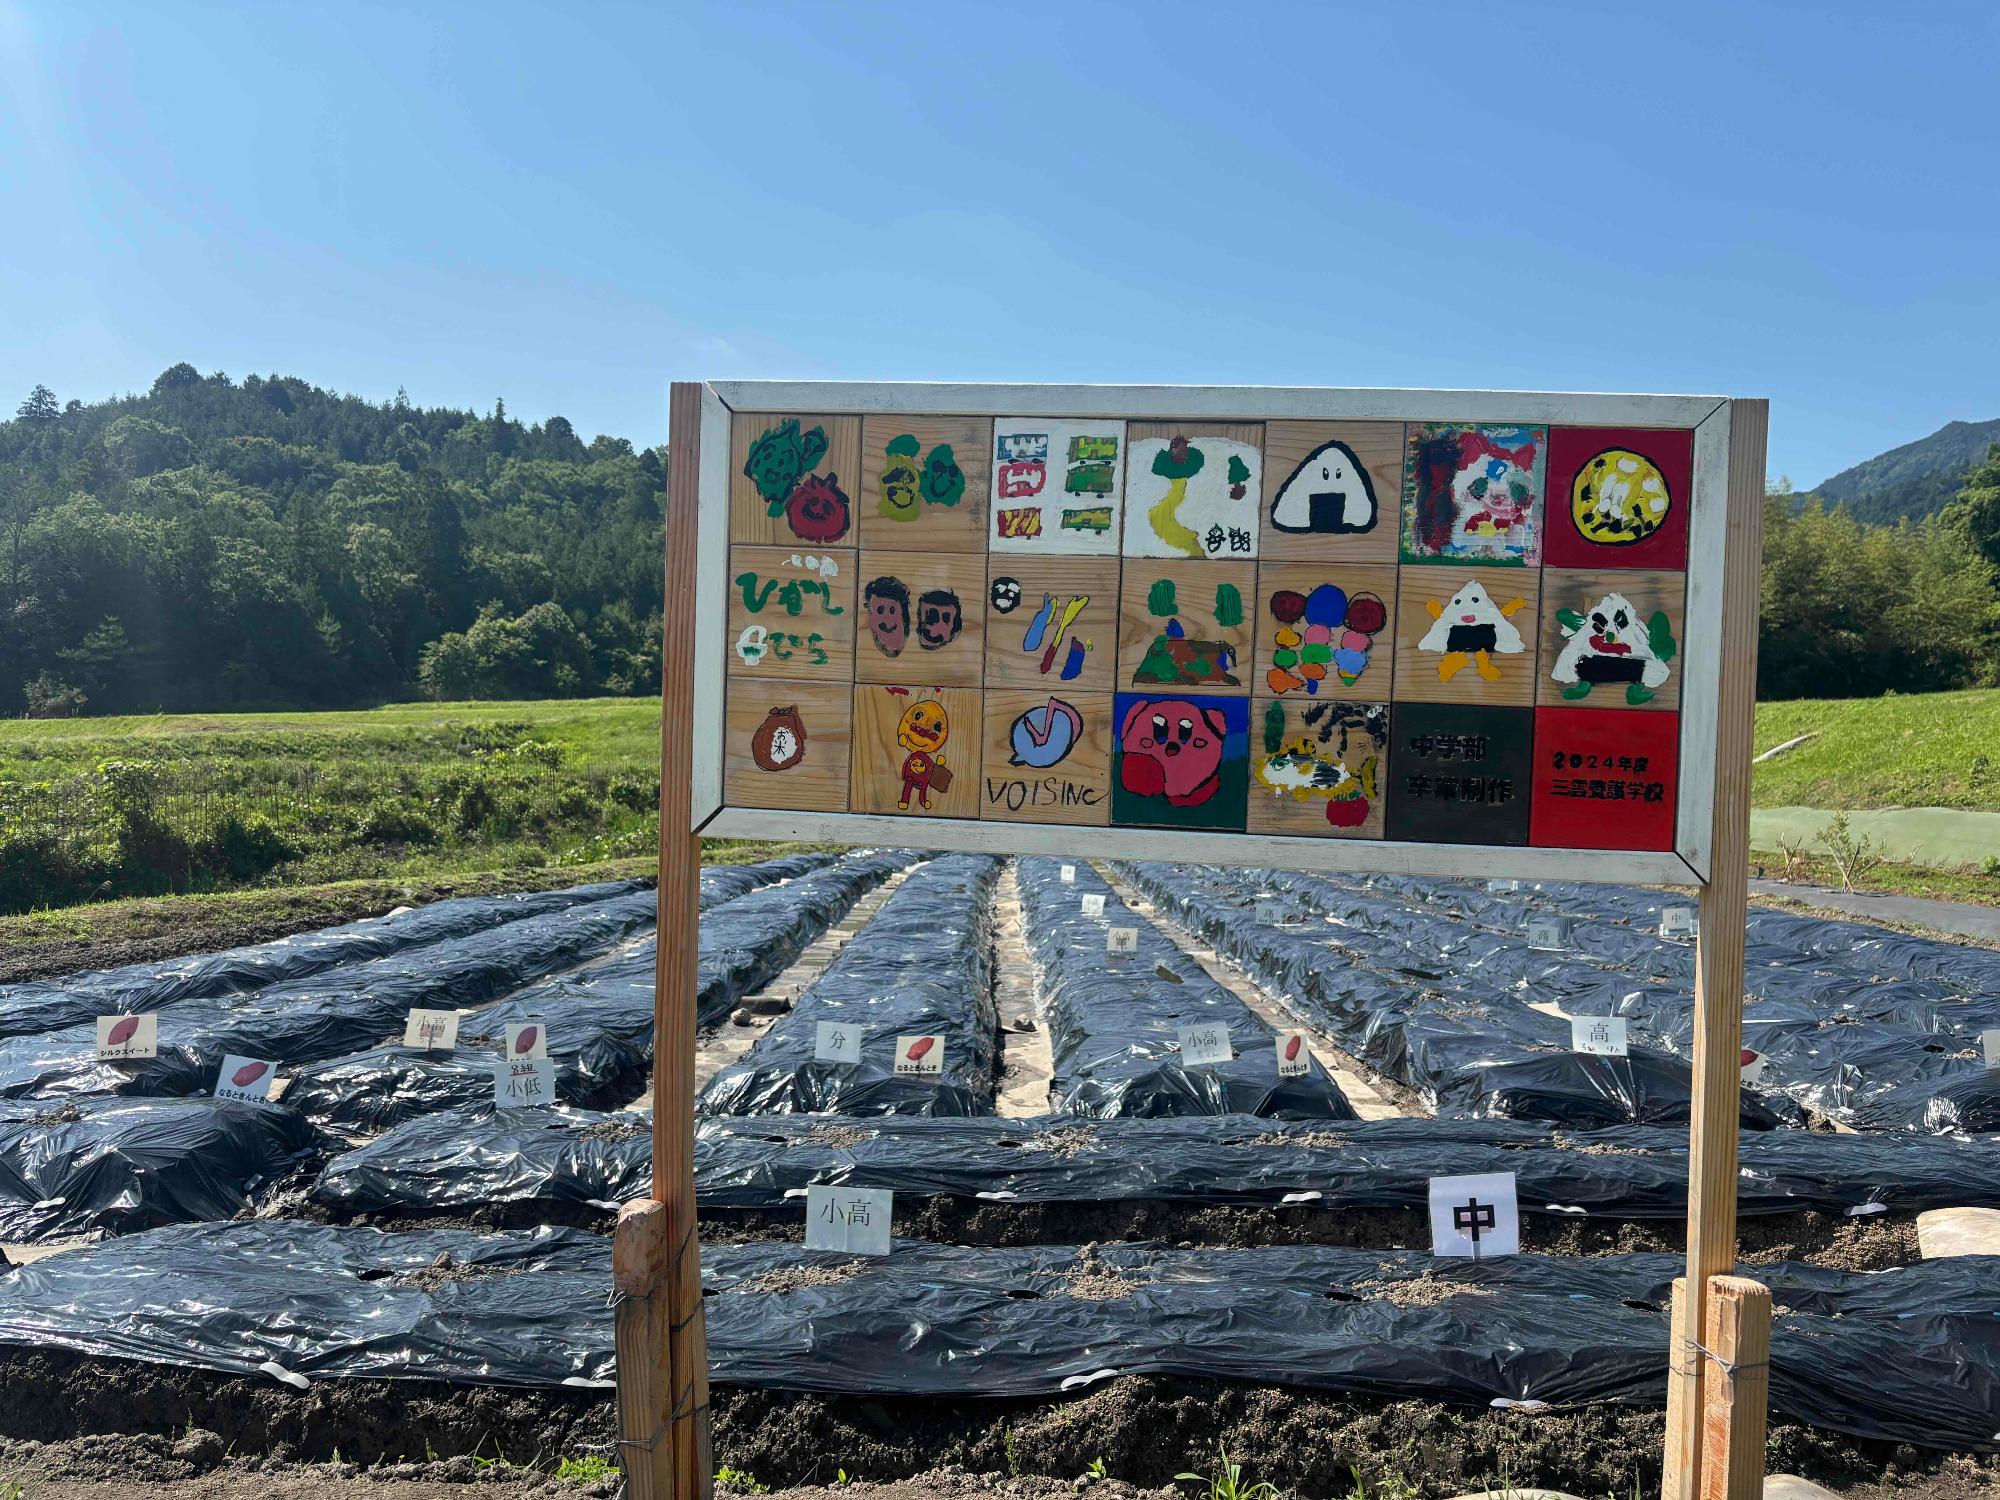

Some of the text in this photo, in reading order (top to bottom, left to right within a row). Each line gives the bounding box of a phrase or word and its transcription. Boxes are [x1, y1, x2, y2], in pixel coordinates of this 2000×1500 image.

[772, 729, 787, 757] お米
[1408, 734, 1488, 762] 中学部
[1552, 751, 1649, 773] 2024年度
[1550, 778, 1664, 802] 三雲養護学校
[415, 1015, 448, 1033] 小高
[1589, 1022, 1609, 1043] 高
[829, 1030, 846, 1049] 分
[1188, 1029, 1218, 1048] 小高
[100, 1047, 150, 1057] シルクスイート
[896, 1063, 938, 1072] なるときんとき
[1280, 1062, 1308, 1074] なるときんとき
[218, 1088, 267, 1104] なるときんとき
[506, 1076, 542, 1098] 小低
[820, 1197, 872, 1227] 小高
[1452, 1197, 1496, 1242] 中
